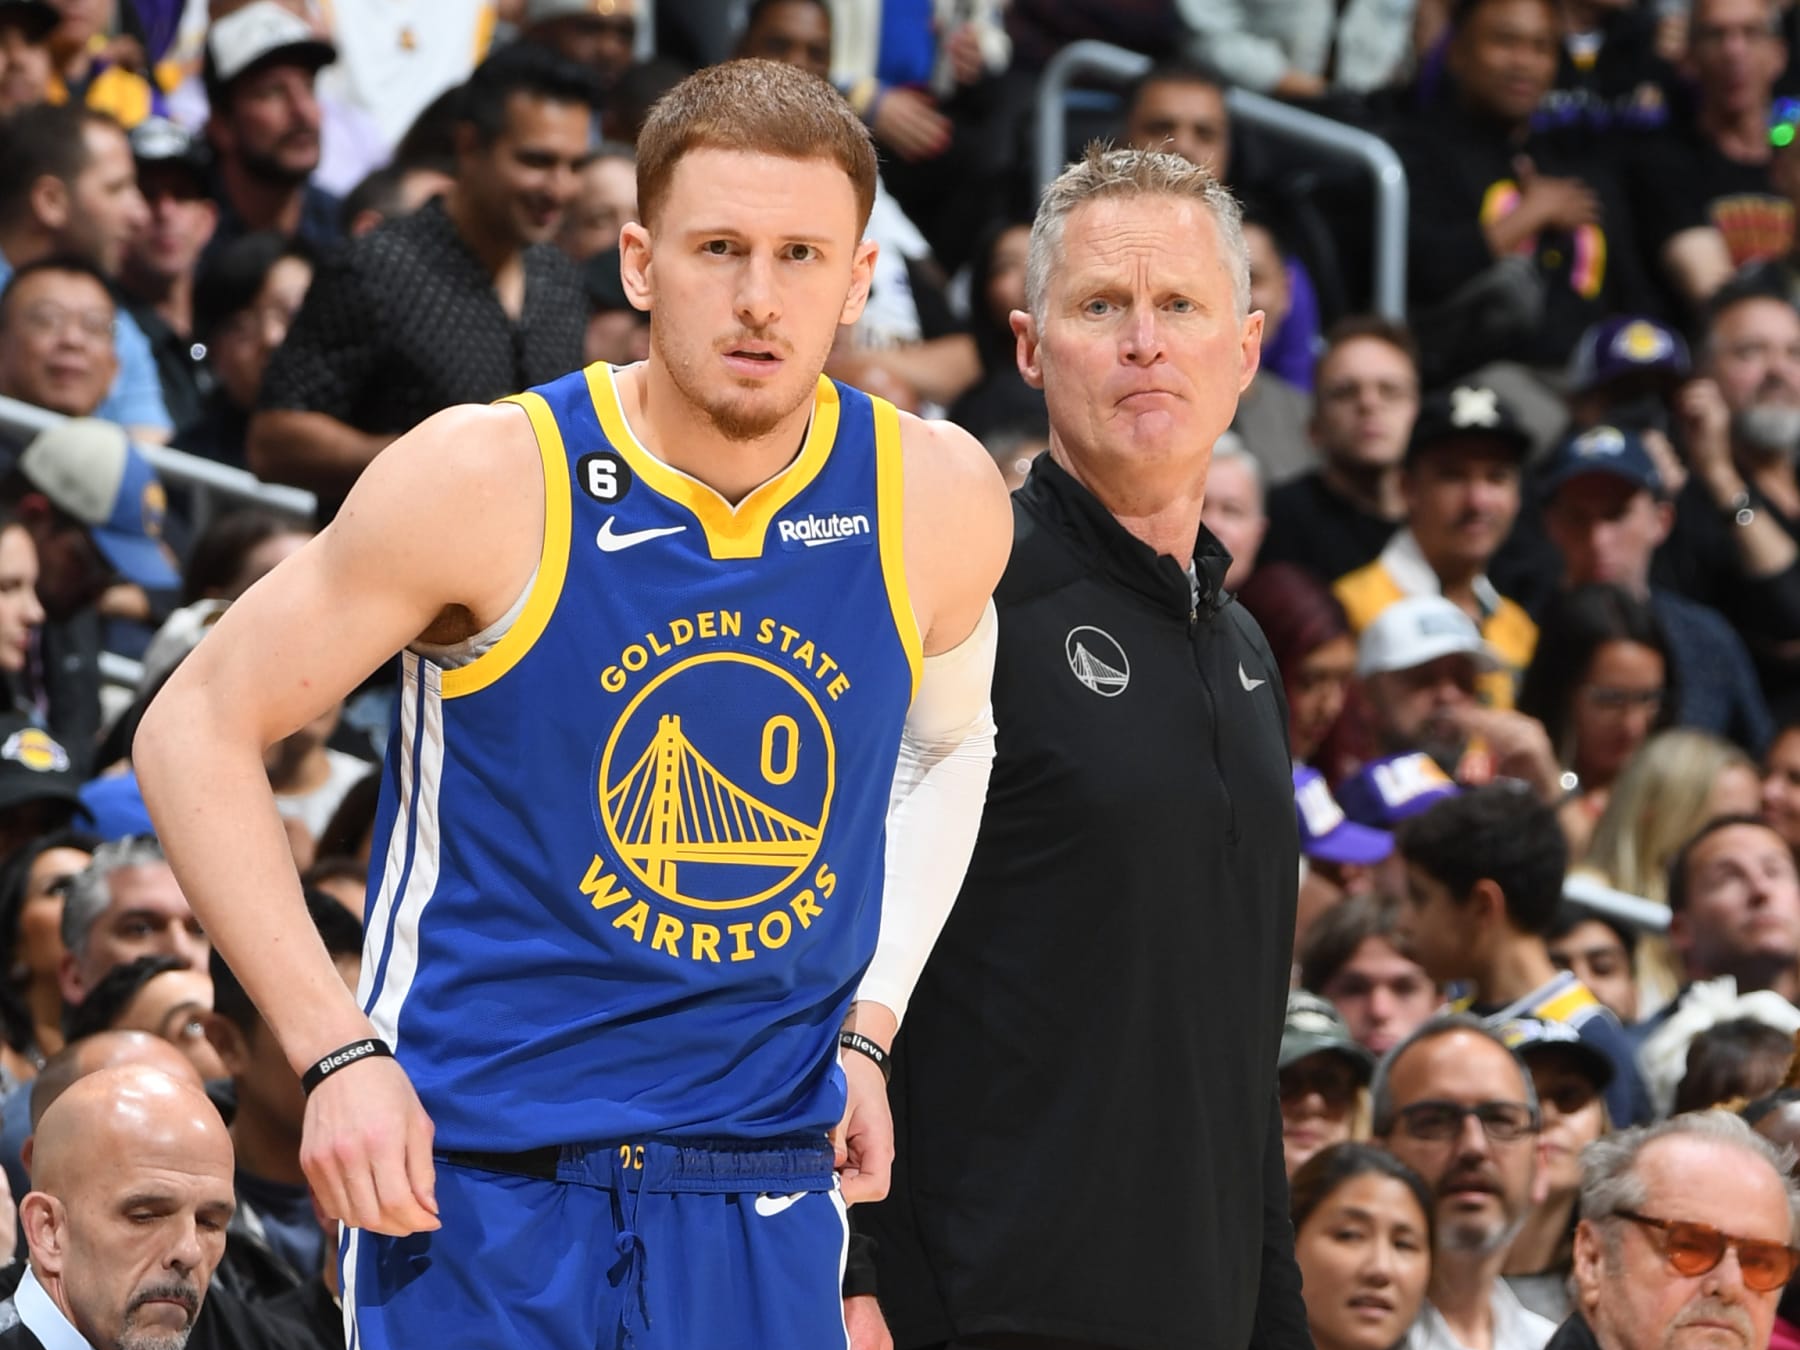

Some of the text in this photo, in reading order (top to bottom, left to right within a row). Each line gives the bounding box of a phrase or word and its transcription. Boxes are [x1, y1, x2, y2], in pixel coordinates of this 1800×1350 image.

[588, 459, 617, 498] 6
[778, 513, 870, 542] Rakuten
[601, 611, 851, 701] GOLDEN STATE
[761, 715, 799, 785] 0
[577, 854, 838, 963] WARRIORS
[319, 1041, 376, 1074] Blessed
[840, 1034, 883, 1062] elieve
